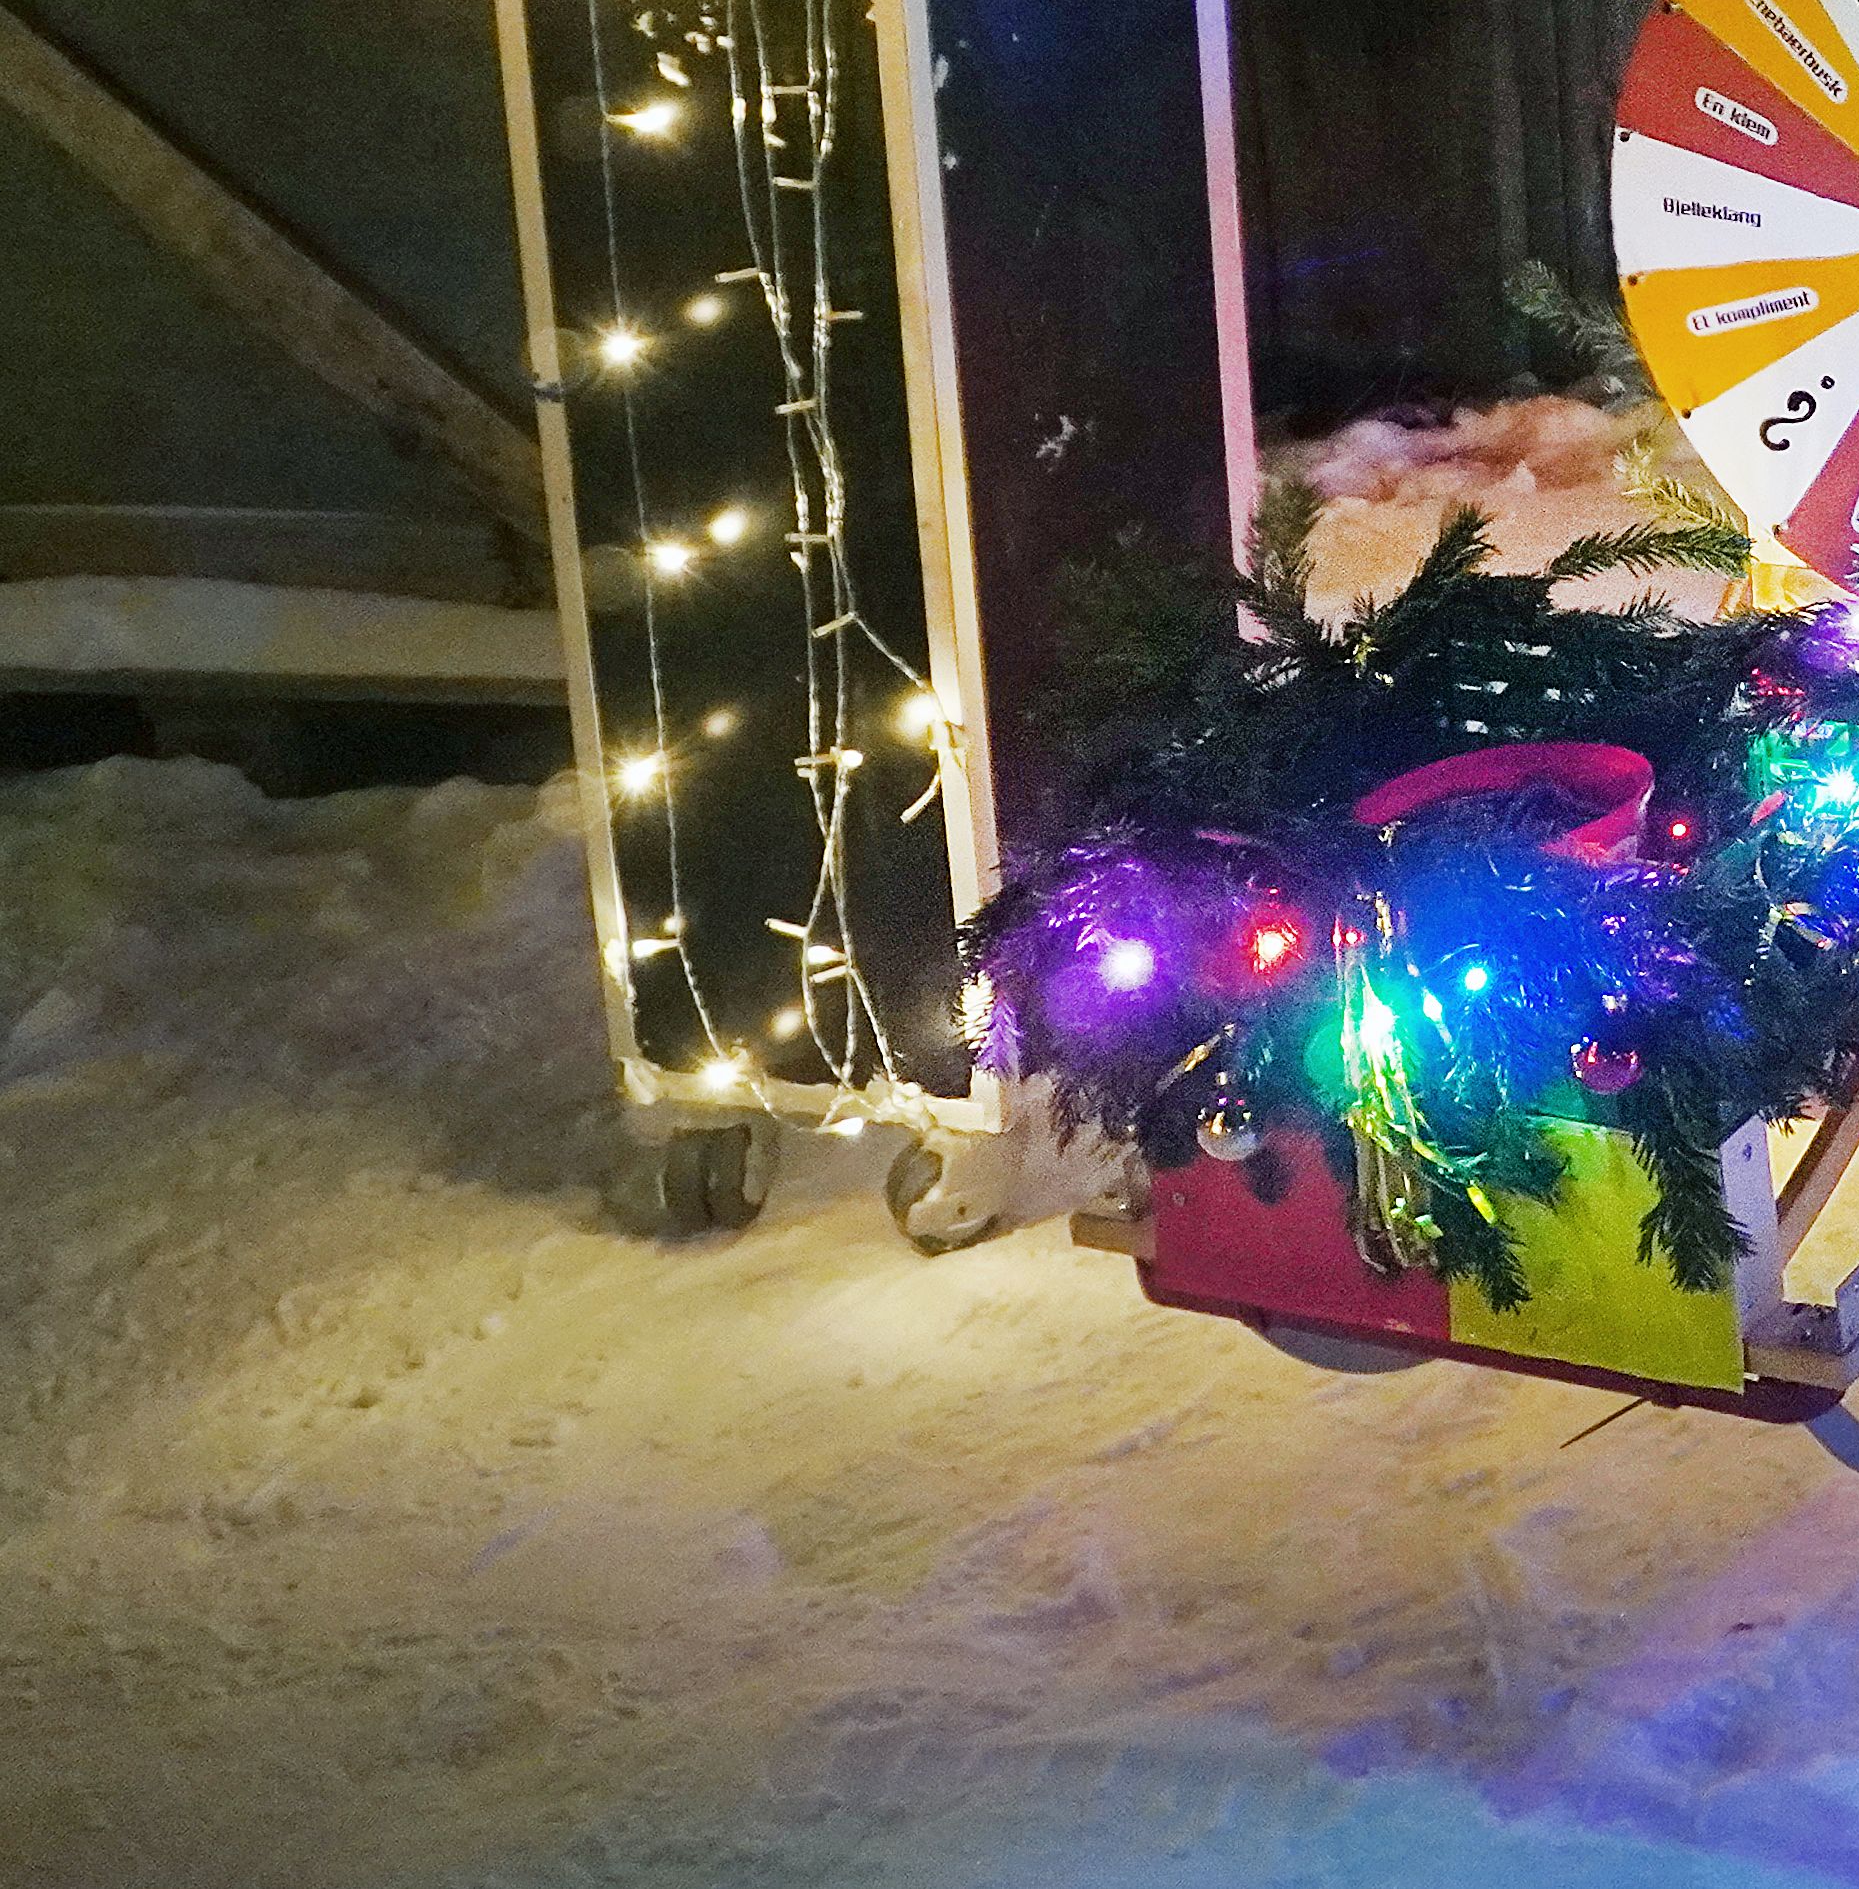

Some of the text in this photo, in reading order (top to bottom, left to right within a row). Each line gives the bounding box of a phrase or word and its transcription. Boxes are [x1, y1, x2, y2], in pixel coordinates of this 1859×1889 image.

[1702, 92, 1772, 142] En klem
[1662, 197, 1761, 227] Bjelleklang
[1692, 290, 1811, 331] Et kompliment
